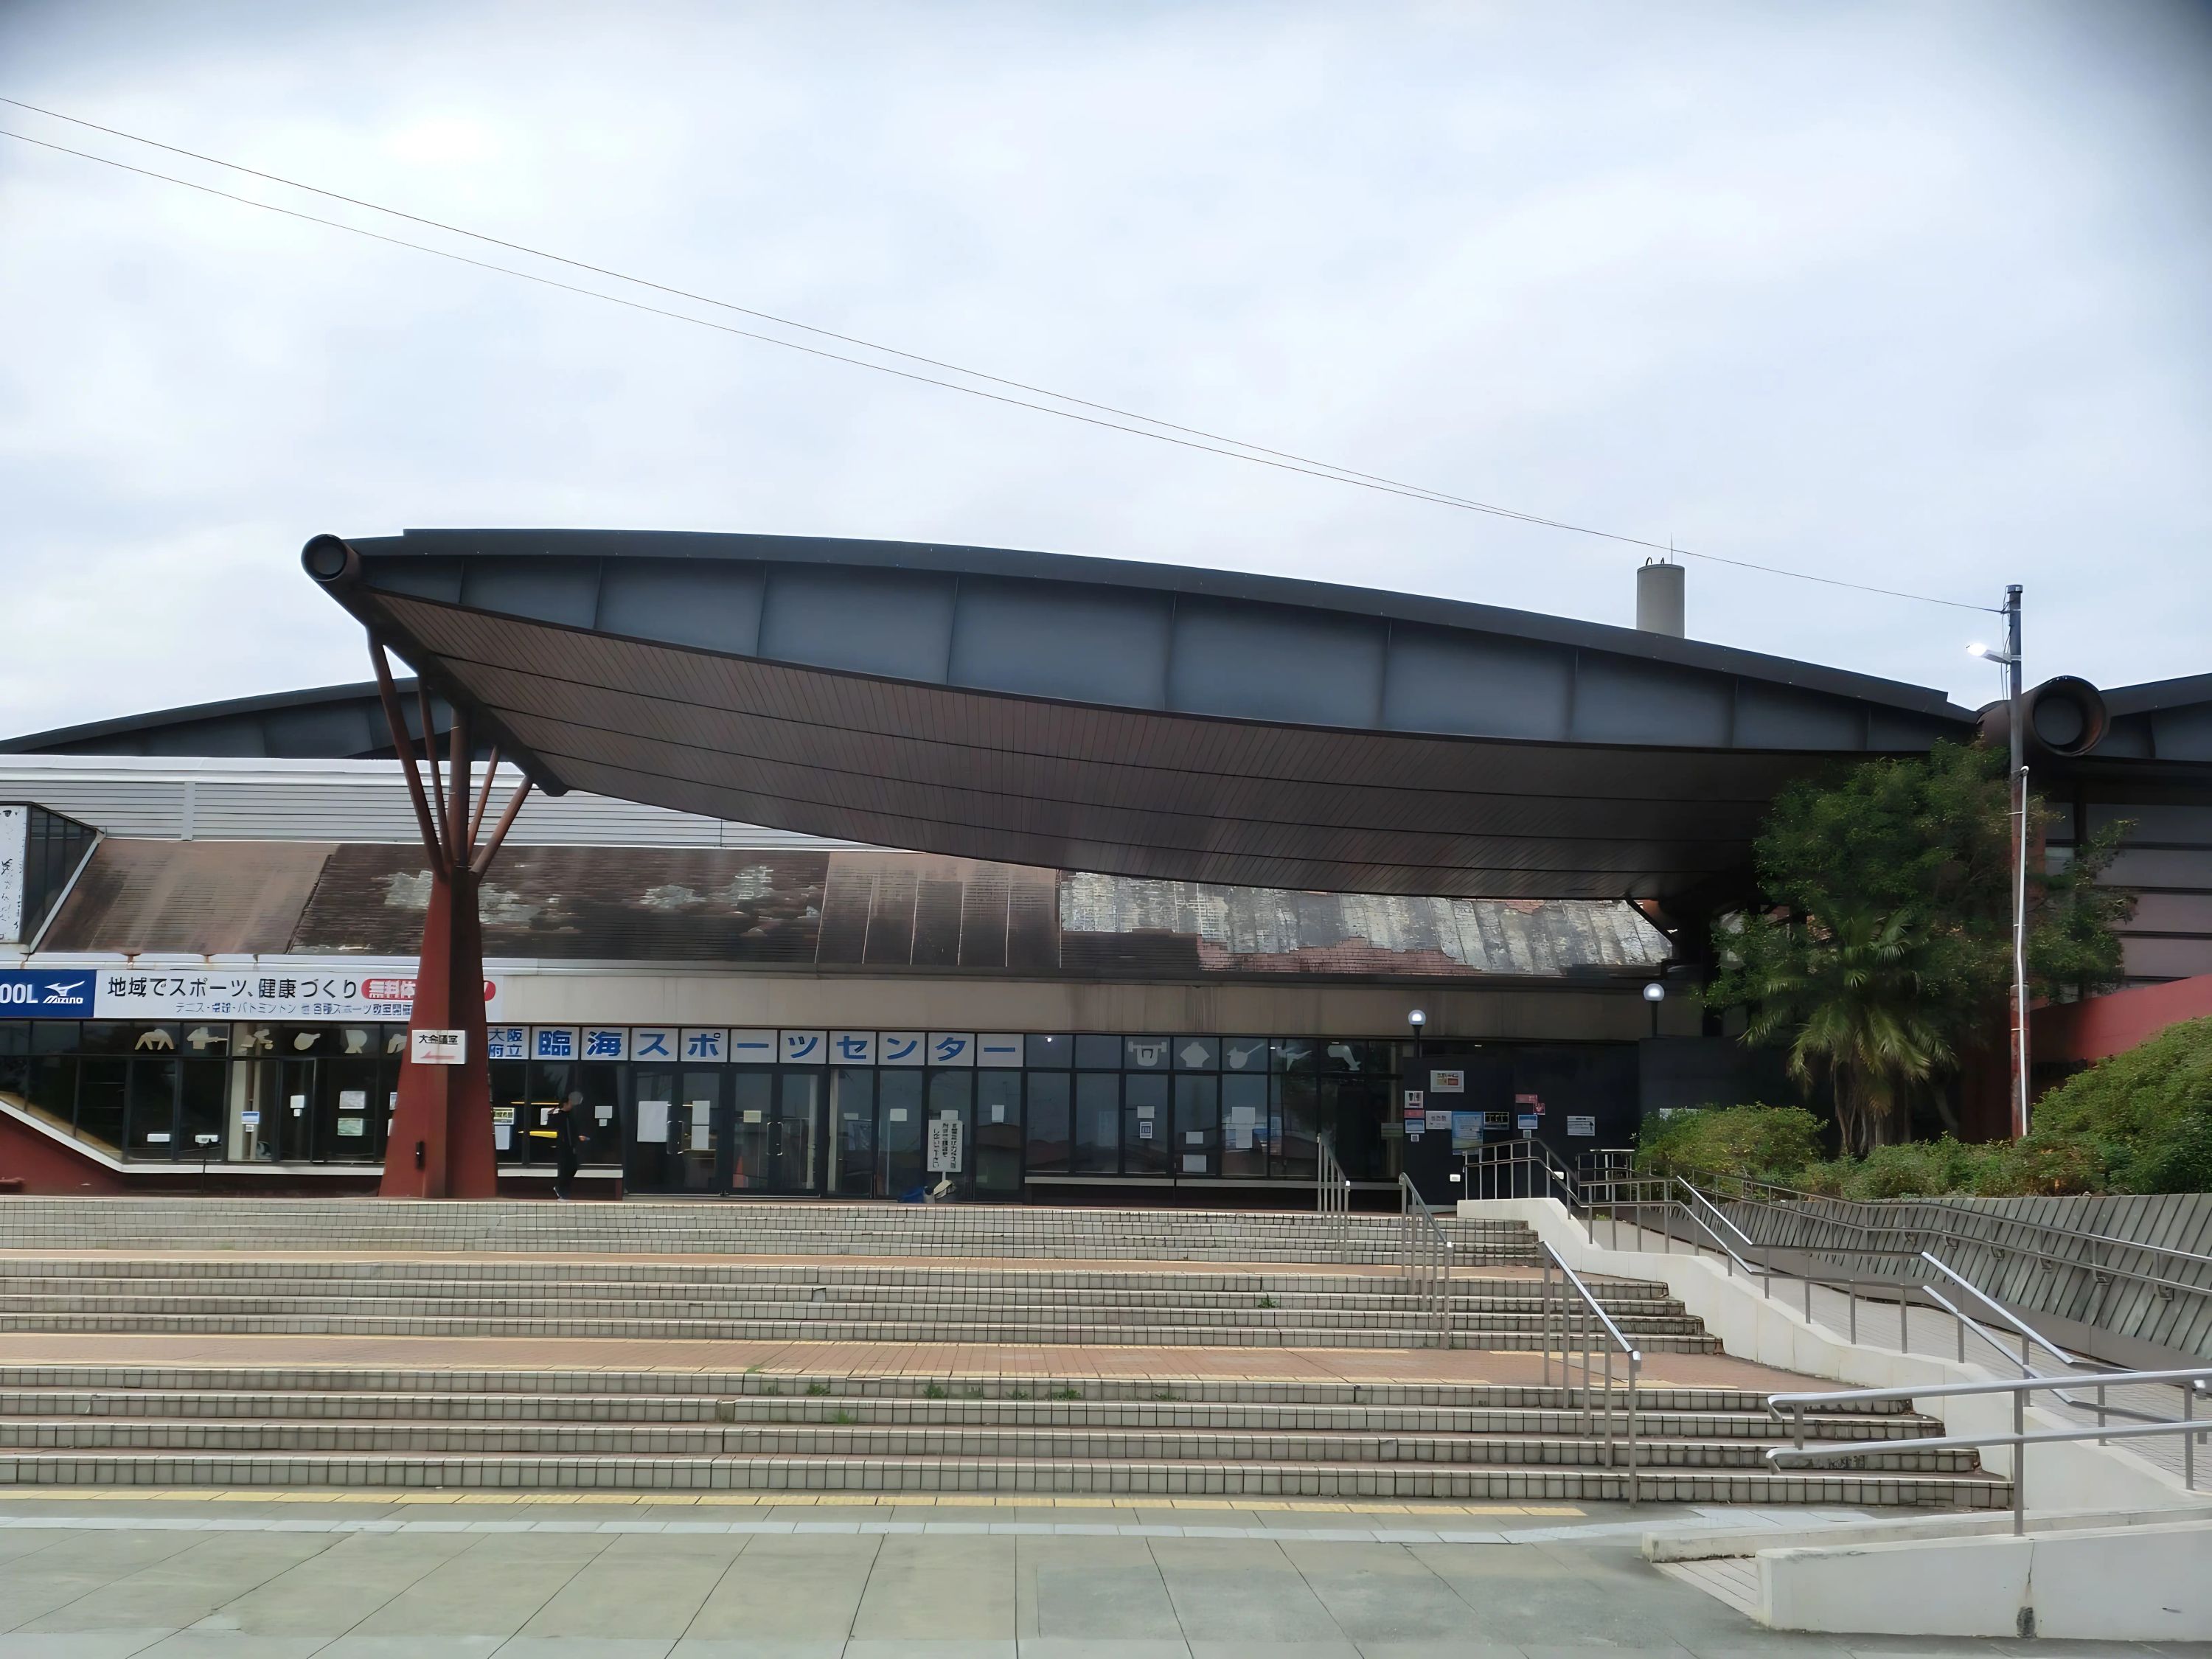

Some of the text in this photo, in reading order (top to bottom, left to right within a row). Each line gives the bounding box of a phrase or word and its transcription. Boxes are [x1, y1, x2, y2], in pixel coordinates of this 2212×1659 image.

[108, 977, 357, 998] 地域でスポーツ、健康づくり
[489, 1028, 523, 1042] 大阪
[489, 1044, 523, 1057] 府立
[538, 1029, 1016, 1062] 臨海スポーツセンター
